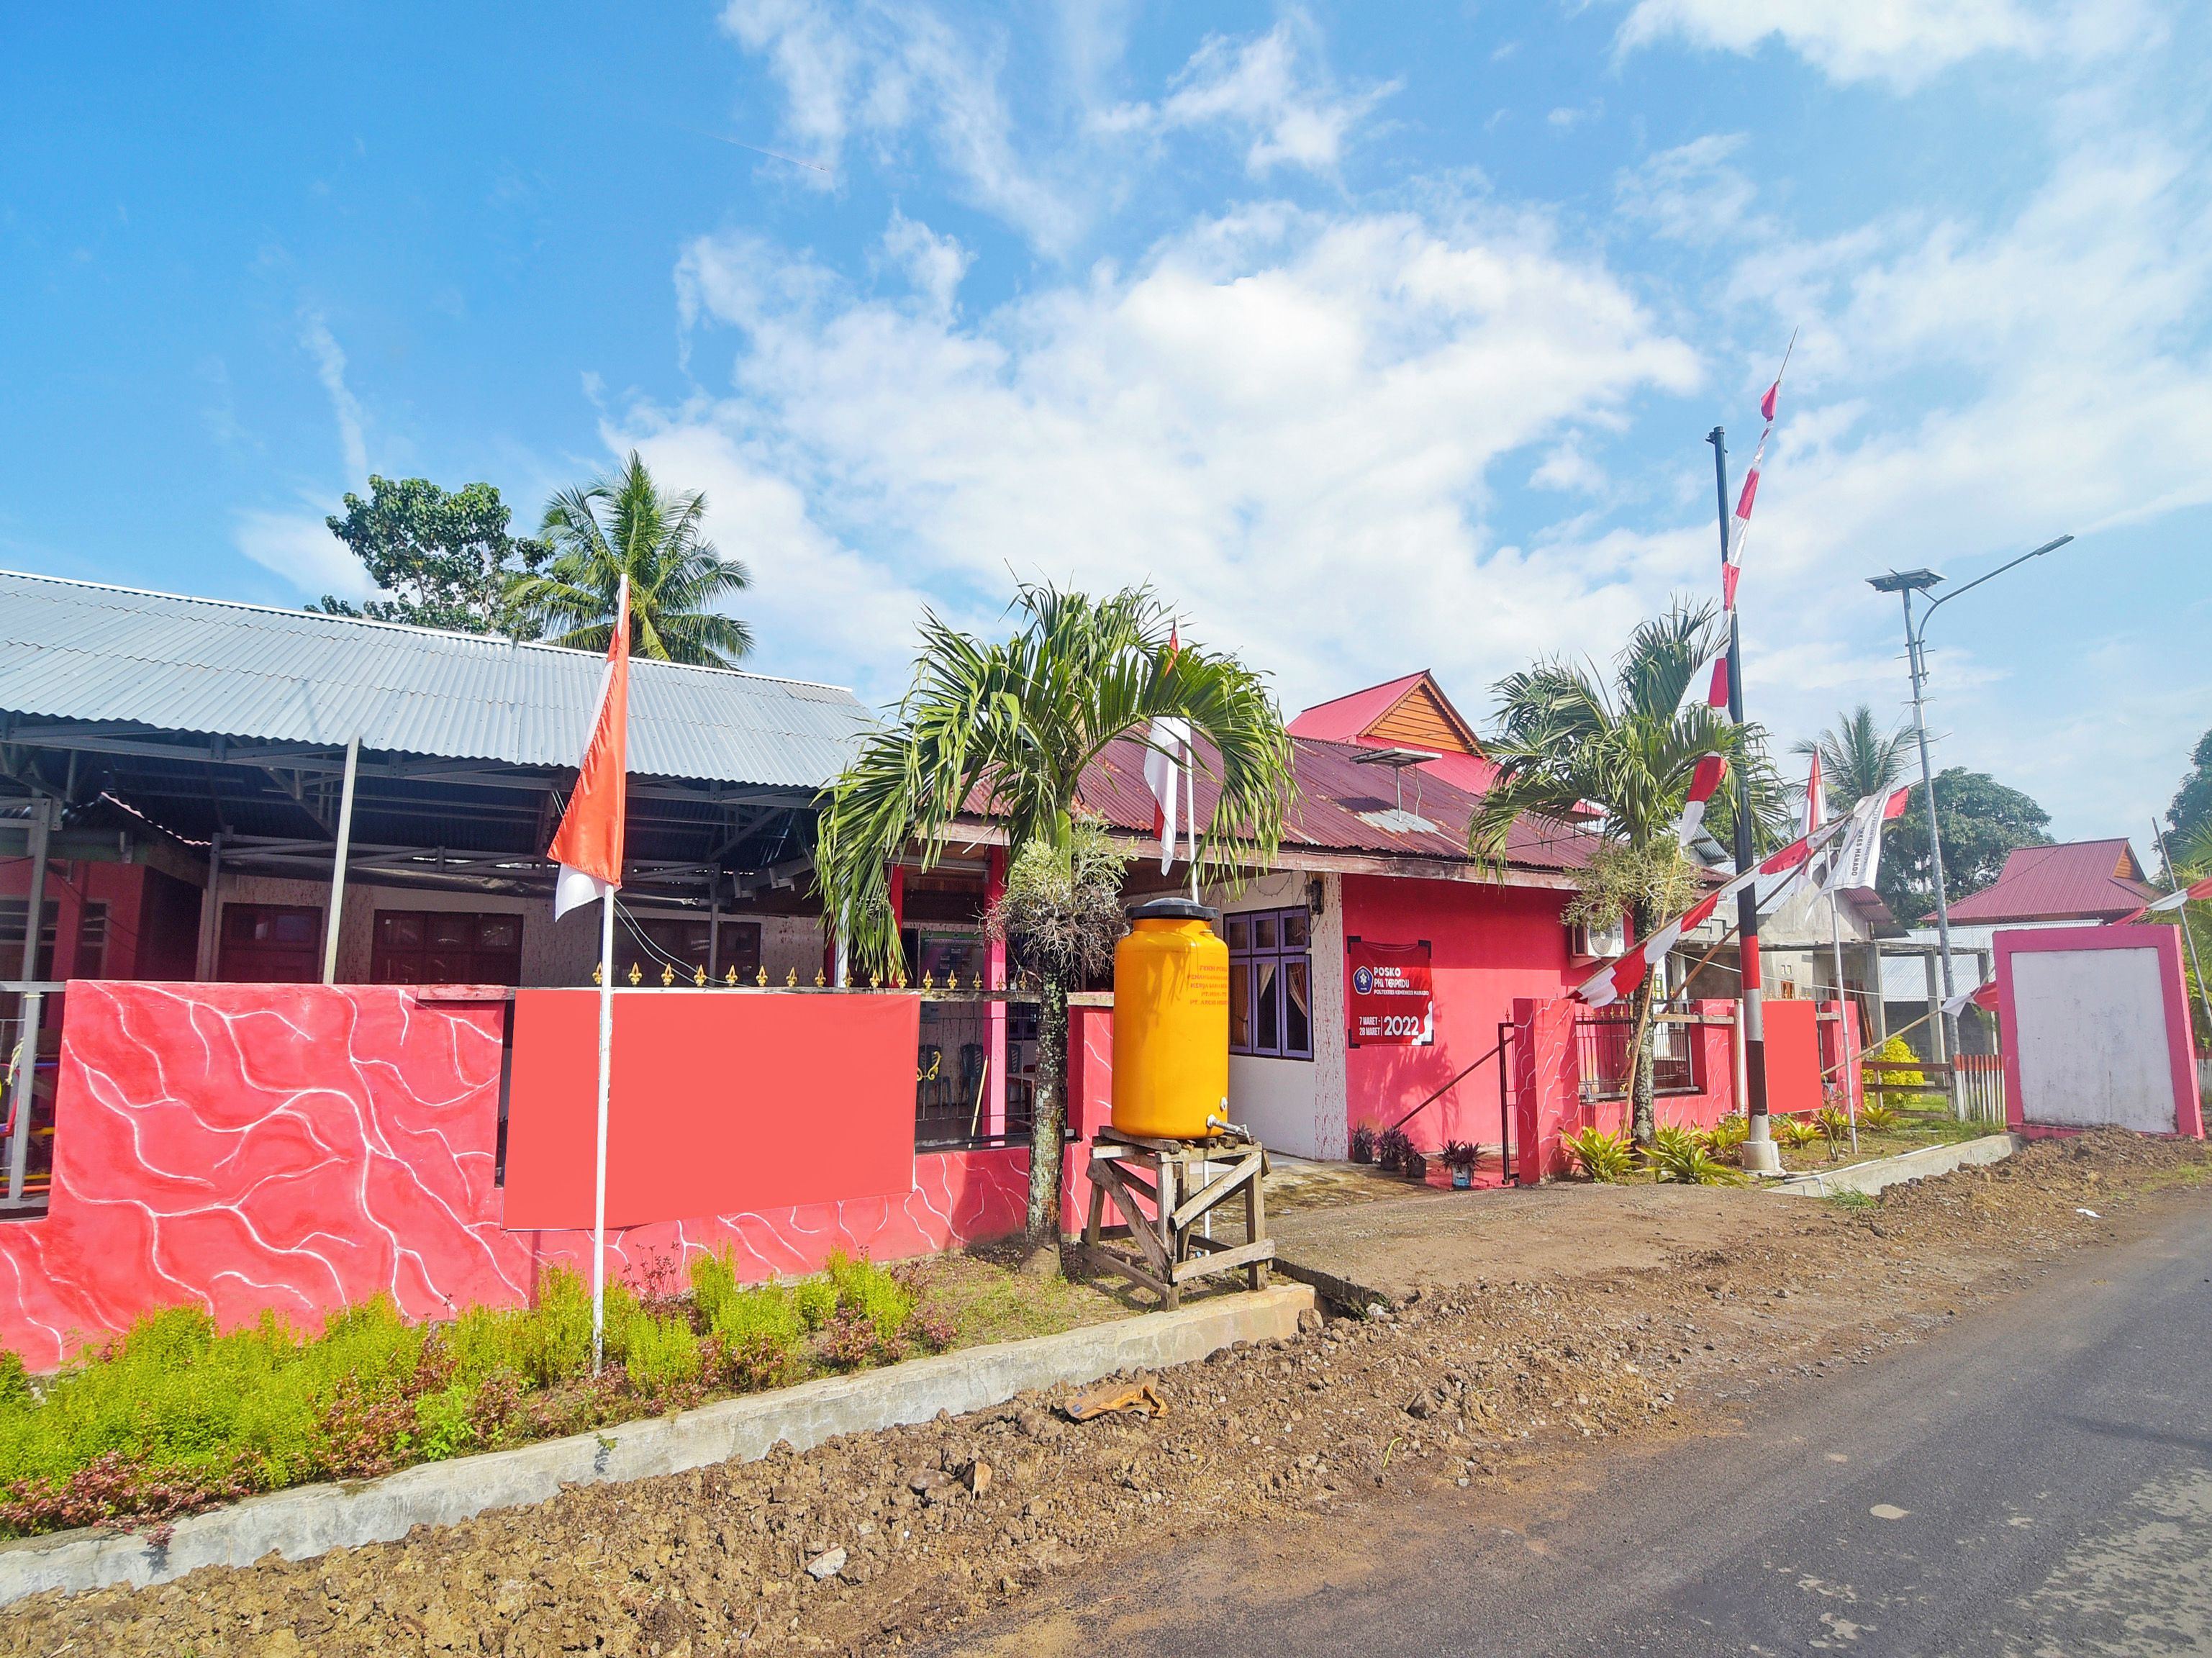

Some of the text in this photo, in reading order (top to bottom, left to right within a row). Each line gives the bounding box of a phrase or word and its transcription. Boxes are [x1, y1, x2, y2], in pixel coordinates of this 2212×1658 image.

[1373, 966, 1402, 977] POSKO
[1384, 979, 1410, 988] TERPADU
[1359, 1016, 1362, 1025] 7
[1363, 1016, 1378, 1025] MARET
[1384, 1015, 1419, 1036] 2022
[1366, 1027, 1381, 1036] MARET
